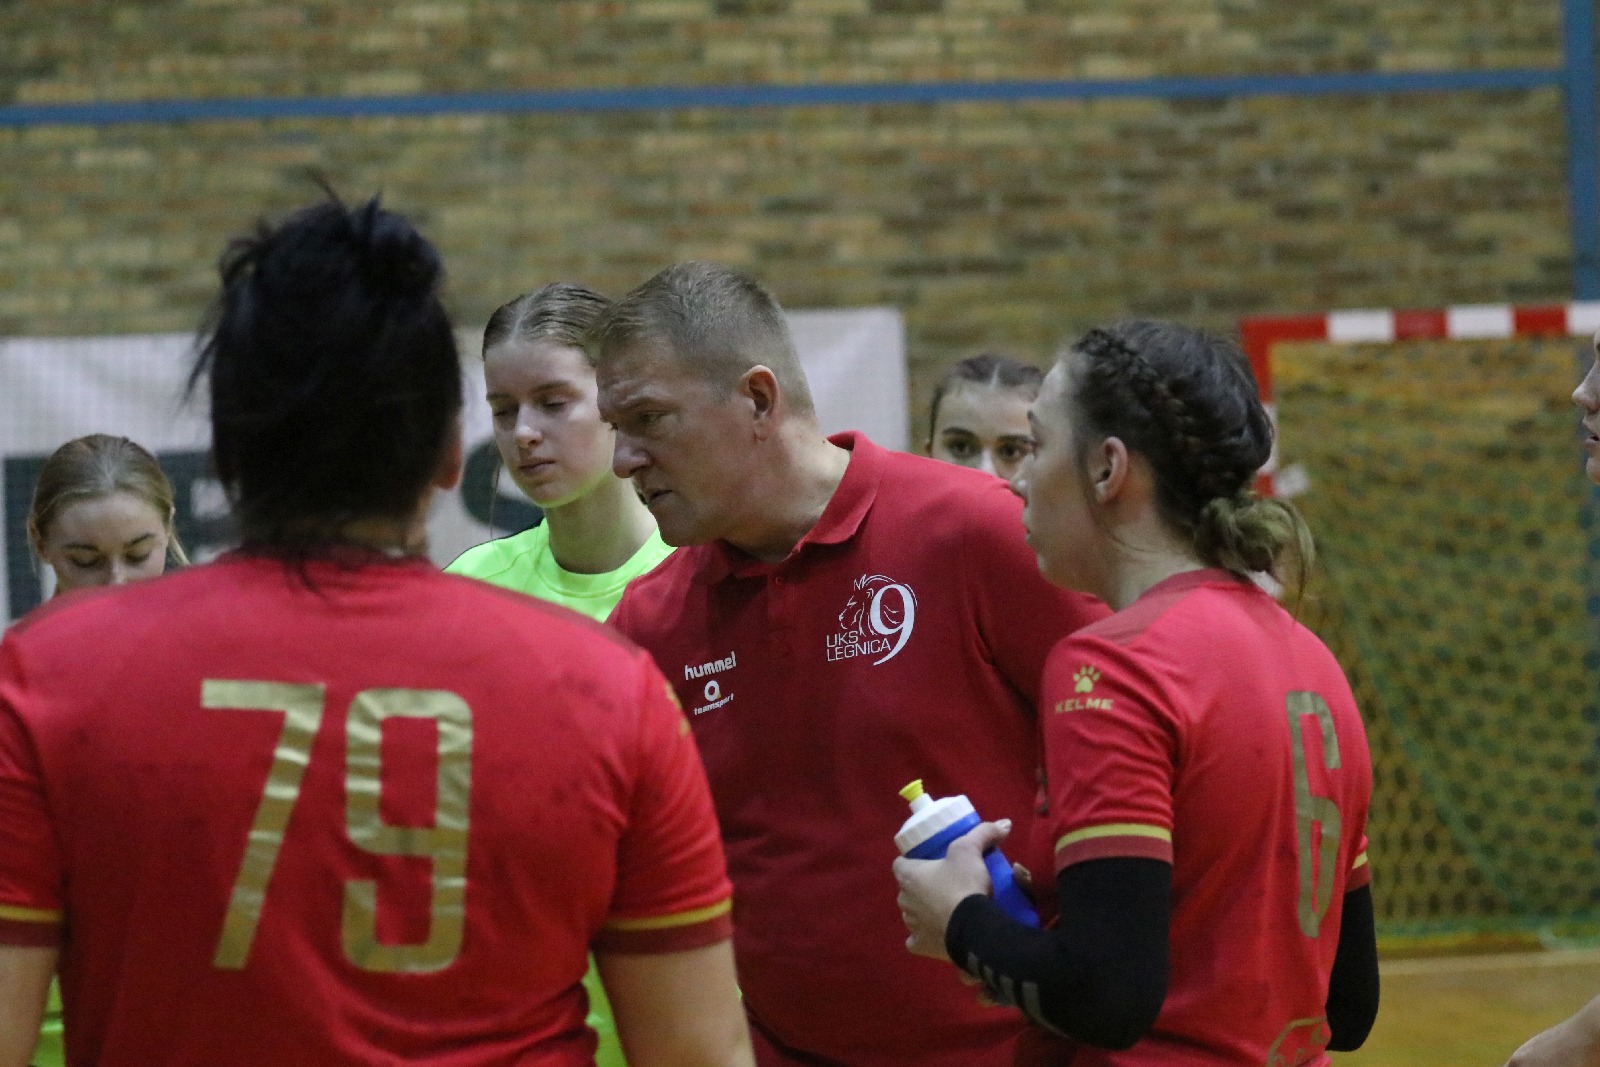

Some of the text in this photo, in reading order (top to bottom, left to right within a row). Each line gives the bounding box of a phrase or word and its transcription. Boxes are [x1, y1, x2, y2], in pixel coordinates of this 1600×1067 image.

[870, 583, 915, 666] 9
[826, 630, 859, 648] UKS
[827, 637, 892, 662] LEGNICA
[684, 650, 737, 681] hummel
[693, 692, 735, 716] teamsport
[1055, 697, 1115, 713] KELME
[201, 678, 474, 974] 79
[1285, 690, 1342, 938] 6
